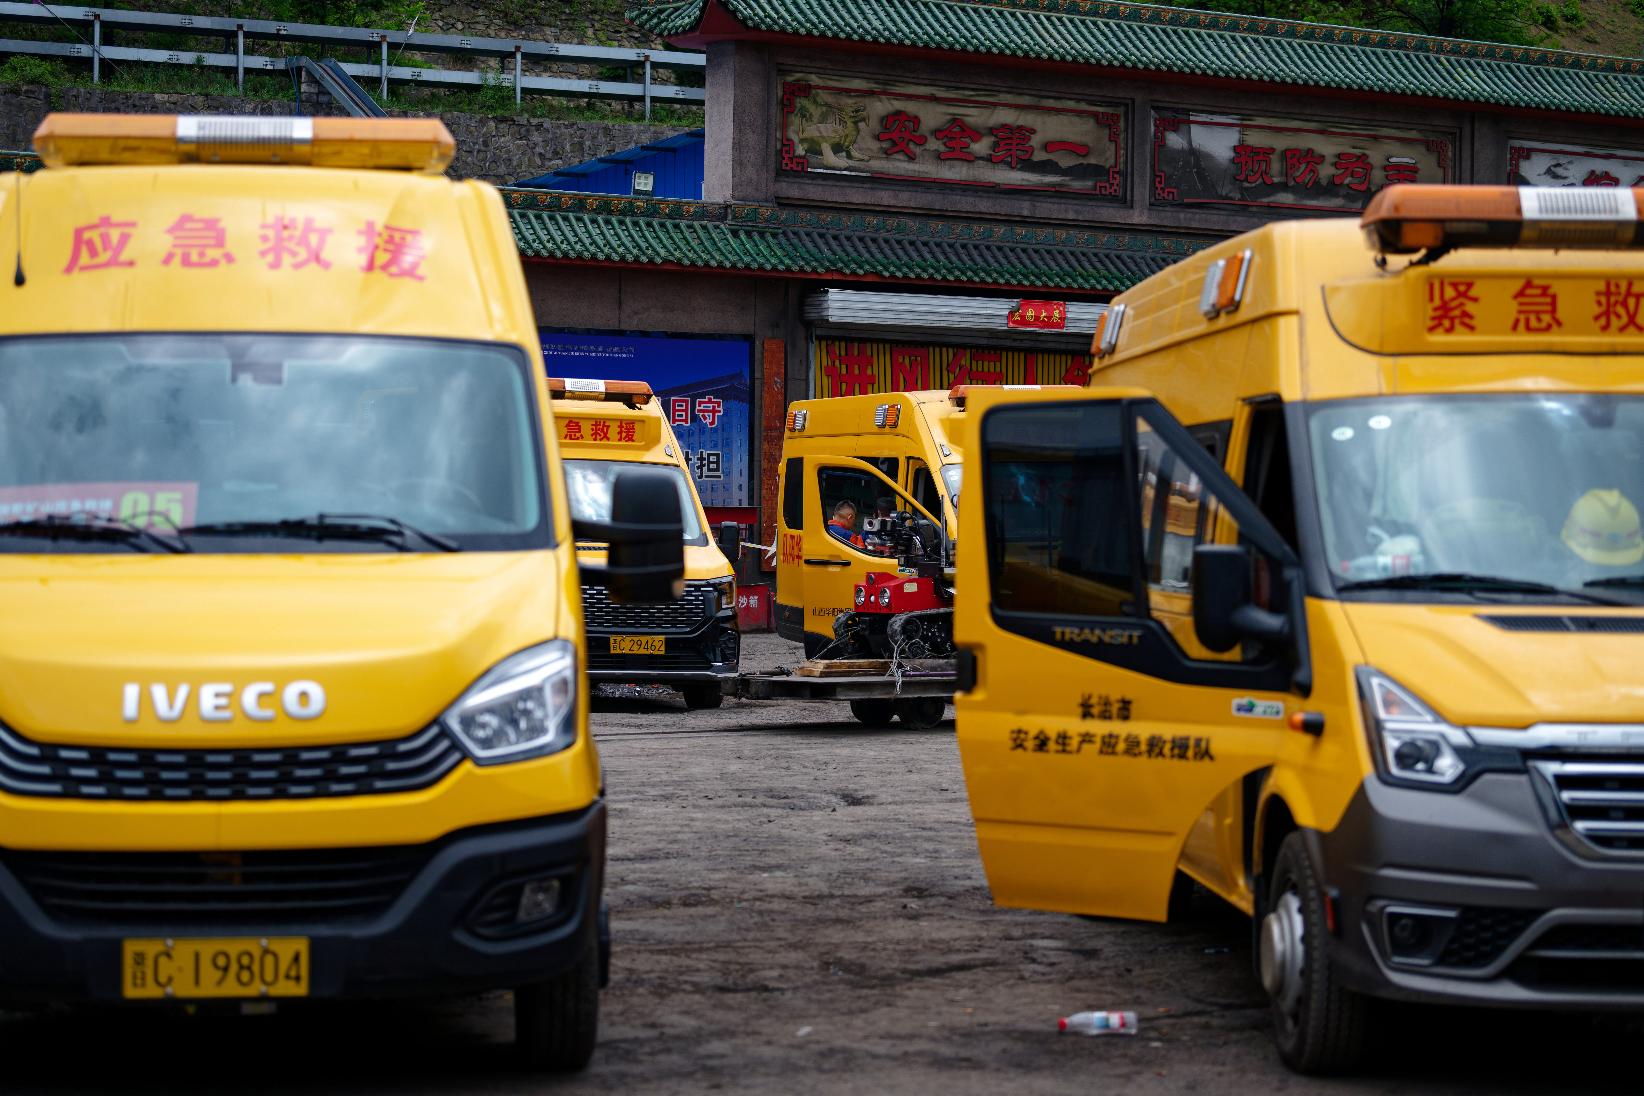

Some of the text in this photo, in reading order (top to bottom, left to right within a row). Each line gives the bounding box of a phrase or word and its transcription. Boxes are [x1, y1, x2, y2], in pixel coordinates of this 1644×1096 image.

[878, 111, 1090, 169] 安全第一
[1232, 143, 1420, 193] 预防为主
[63, 213, 428, 282] 应急救援
[1426, 278, 1644, 333] 紧急救
[824, 340, 1092, 394] 进风行
[657, 396, 723, 427] 日守
[564, 420, 636, 443] 急救援
[120, 491, 184, 529] 05
[738, 595, 759, 608] 沙箱
[1052, 626, 1144, 645] TRANSIT
[122, 680, 327, 722] IVECO
[1078, 694, 1133, 722] 长治市
[1009, 728, 1216, 763] 安全生产应急救援队
